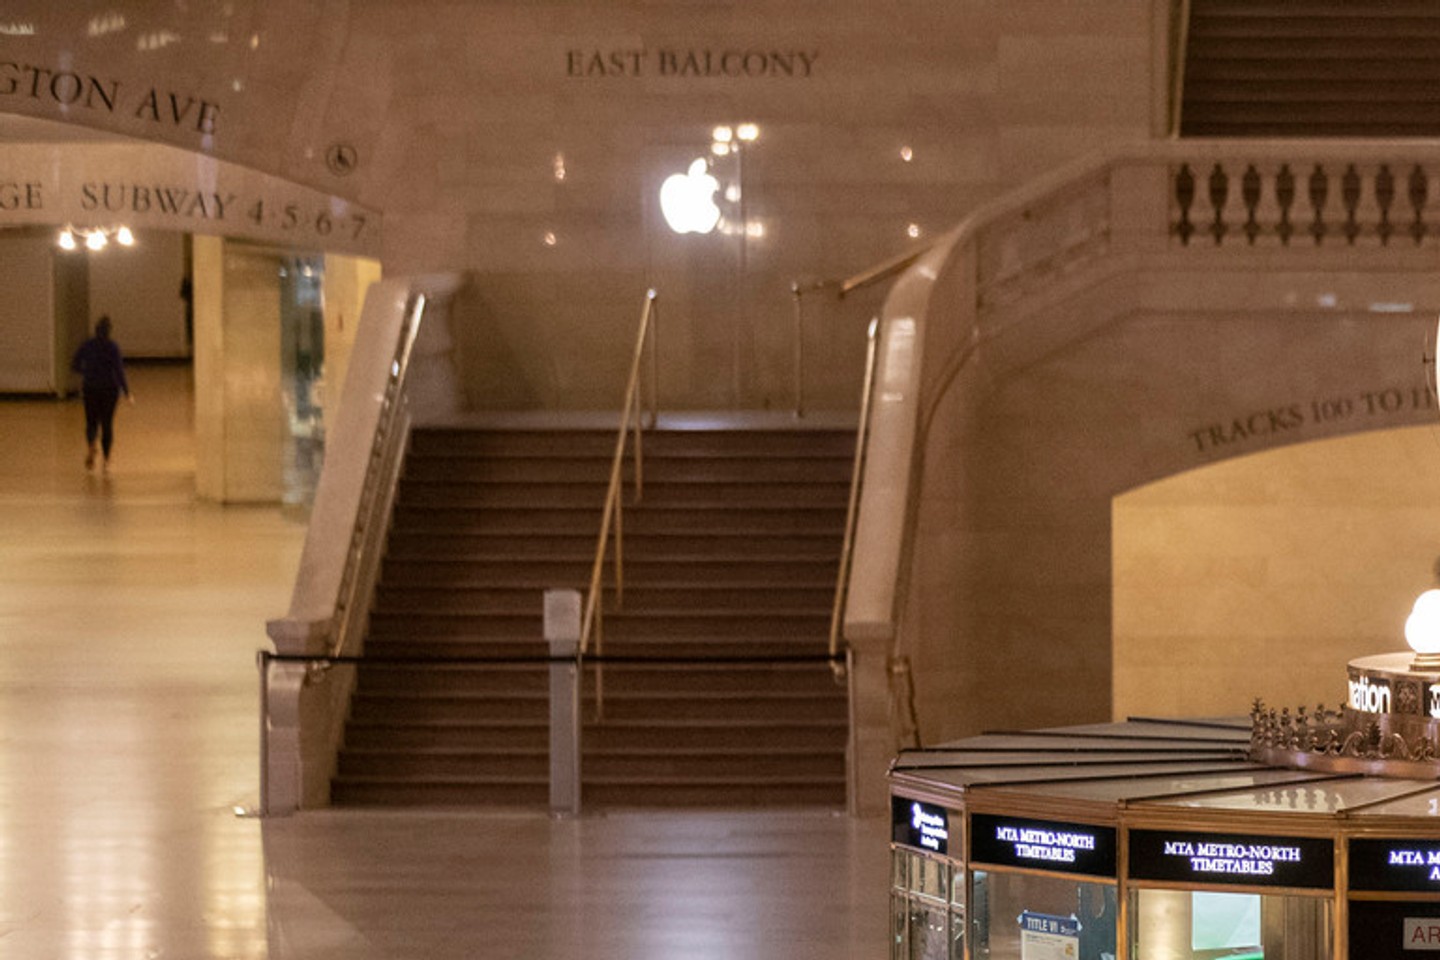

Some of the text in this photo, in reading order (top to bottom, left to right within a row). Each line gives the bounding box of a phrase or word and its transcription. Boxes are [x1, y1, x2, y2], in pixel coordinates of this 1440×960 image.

[566, 51, 818, 78] EAST BALCONY
[135, 87, 219, 134] AVE
[81, 182, 236, 220] SUBWAY
[1189, 403, 1304, 450] TRACKS
[1361, 388, 1402, 414] TO
[995, 826, 1095, 850] MTA METRO-NORTH
[1014, 843, 1076, 863] TIMETABLES
[1164, 841, 1301, 862] MTA METRO-NORTH
[1389, 850, 1424, 865] MTA
[1190, 858, 1274, 875] TIMETABLES
[1027, 917, 1048, 931] TITLE
